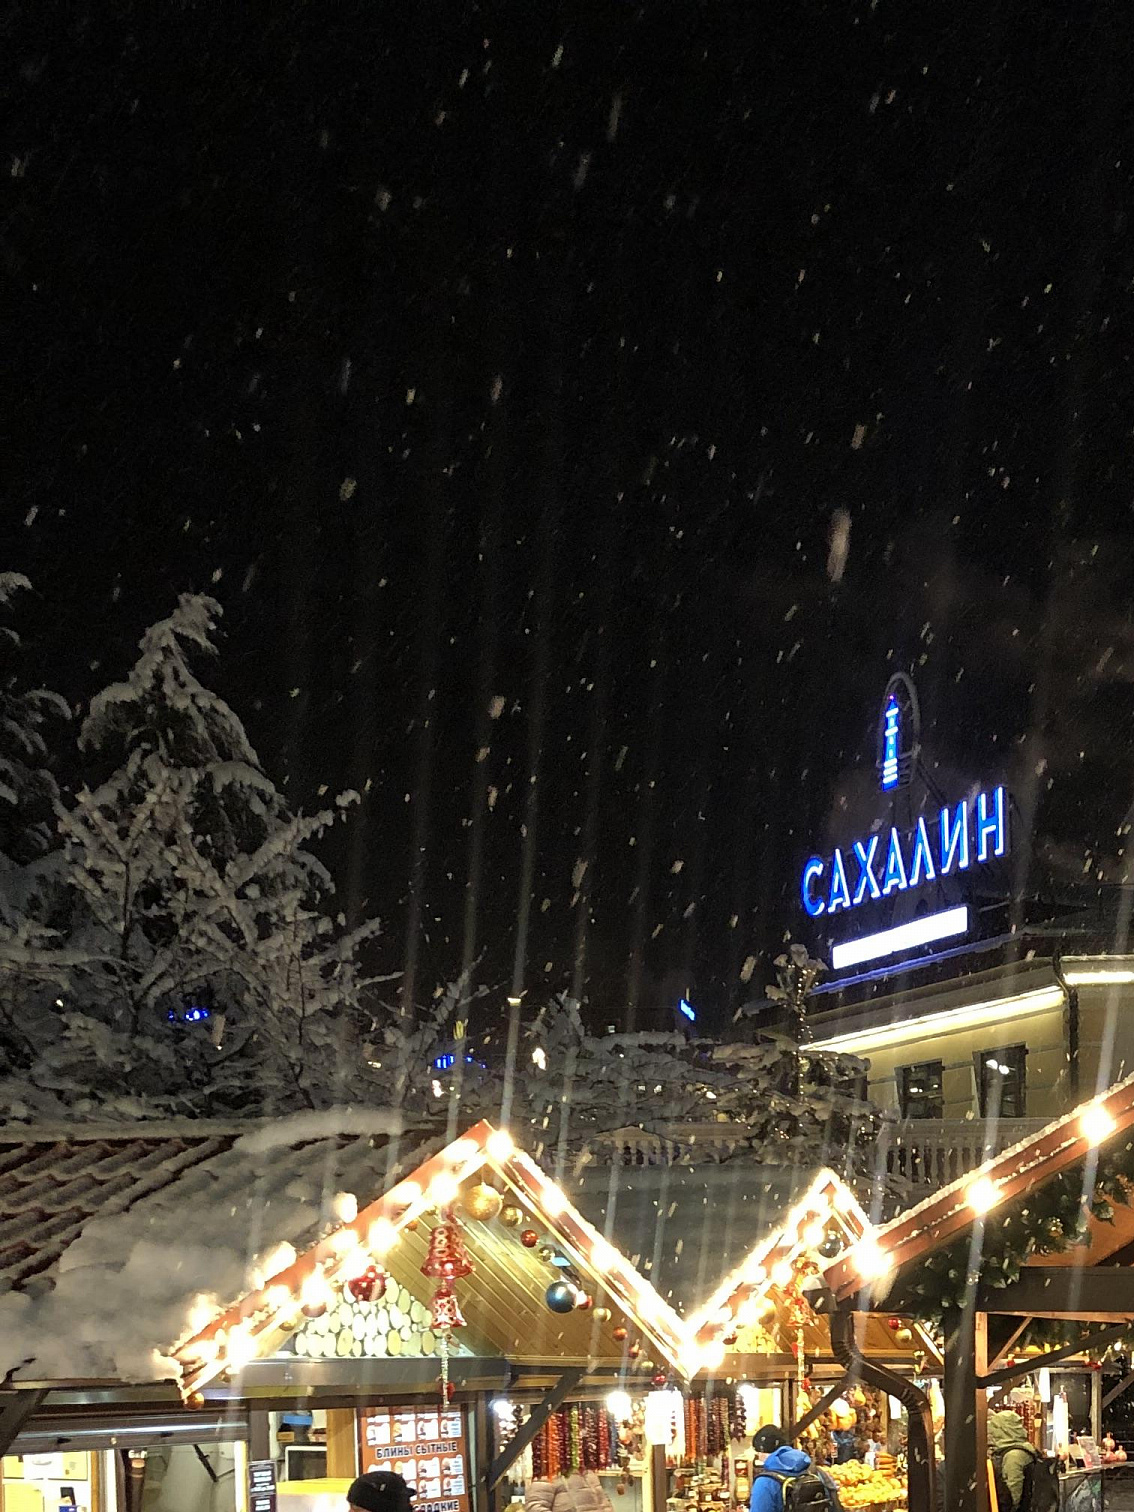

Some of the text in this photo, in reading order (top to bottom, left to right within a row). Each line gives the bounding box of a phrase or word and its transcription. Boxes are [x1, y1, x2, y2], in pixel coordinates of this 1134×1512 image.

[800, 785, 1008, 918] САХАЛИН
[376, 1442, 458, 1460] БЛИНЫ СЫТНЫЕ
